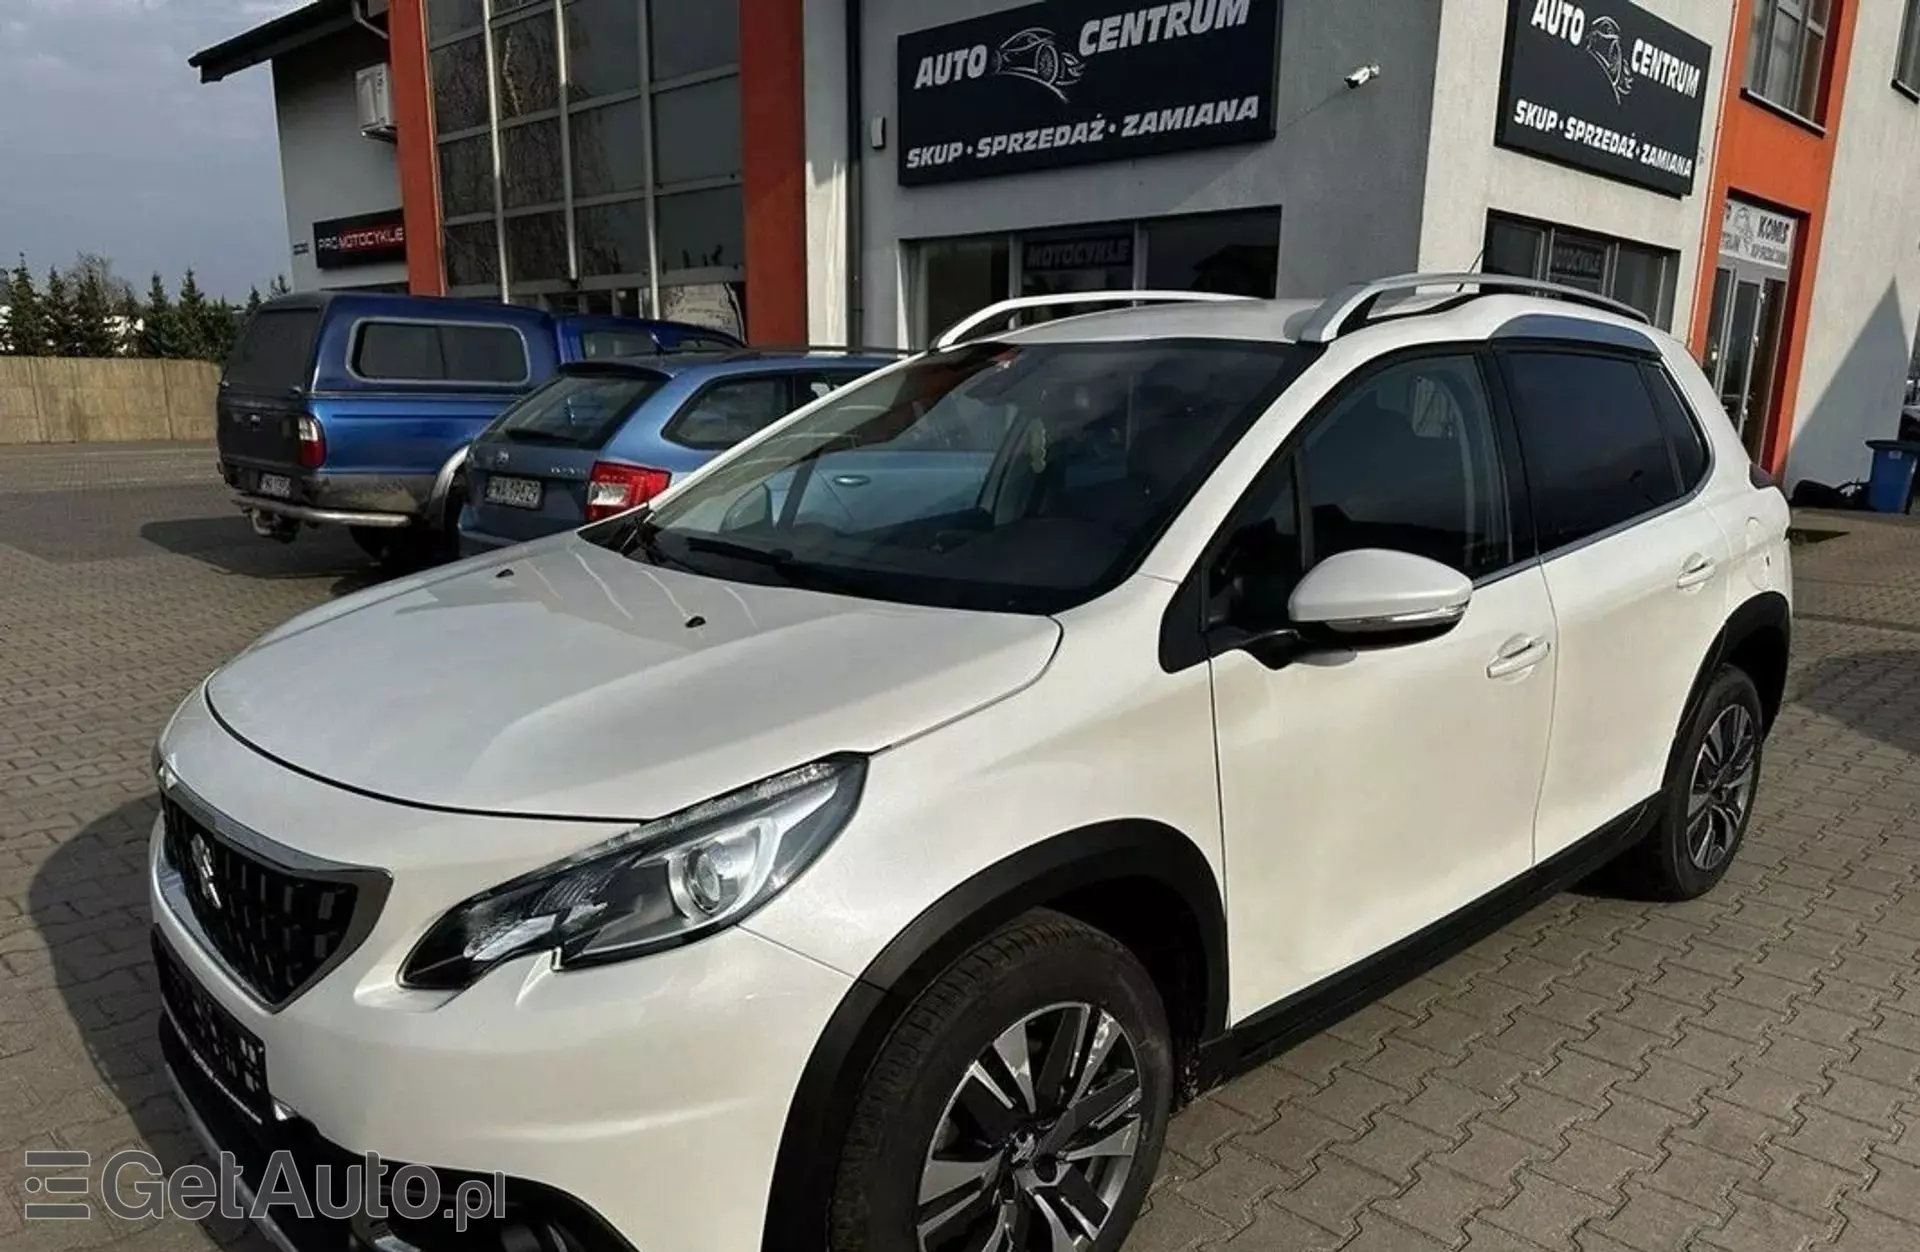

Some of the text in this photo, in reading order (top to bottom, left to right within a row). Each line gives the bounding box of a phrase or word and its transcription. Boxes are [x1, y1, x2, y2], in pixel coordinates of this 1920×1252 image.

[914, 0, 1252, 89] AUTO CENTRUM
[1531, 0, 1701, 99] AUTO CENTRUM
[906, 96, 1259, 169] SKUP SPRZEDAŻ ZAMIANA
[1513, 99, 1692, 177] SKUP SPRZEDAŻ ZAMIANA
[1026, 239, 1131, 268] MOTOCYKLE
